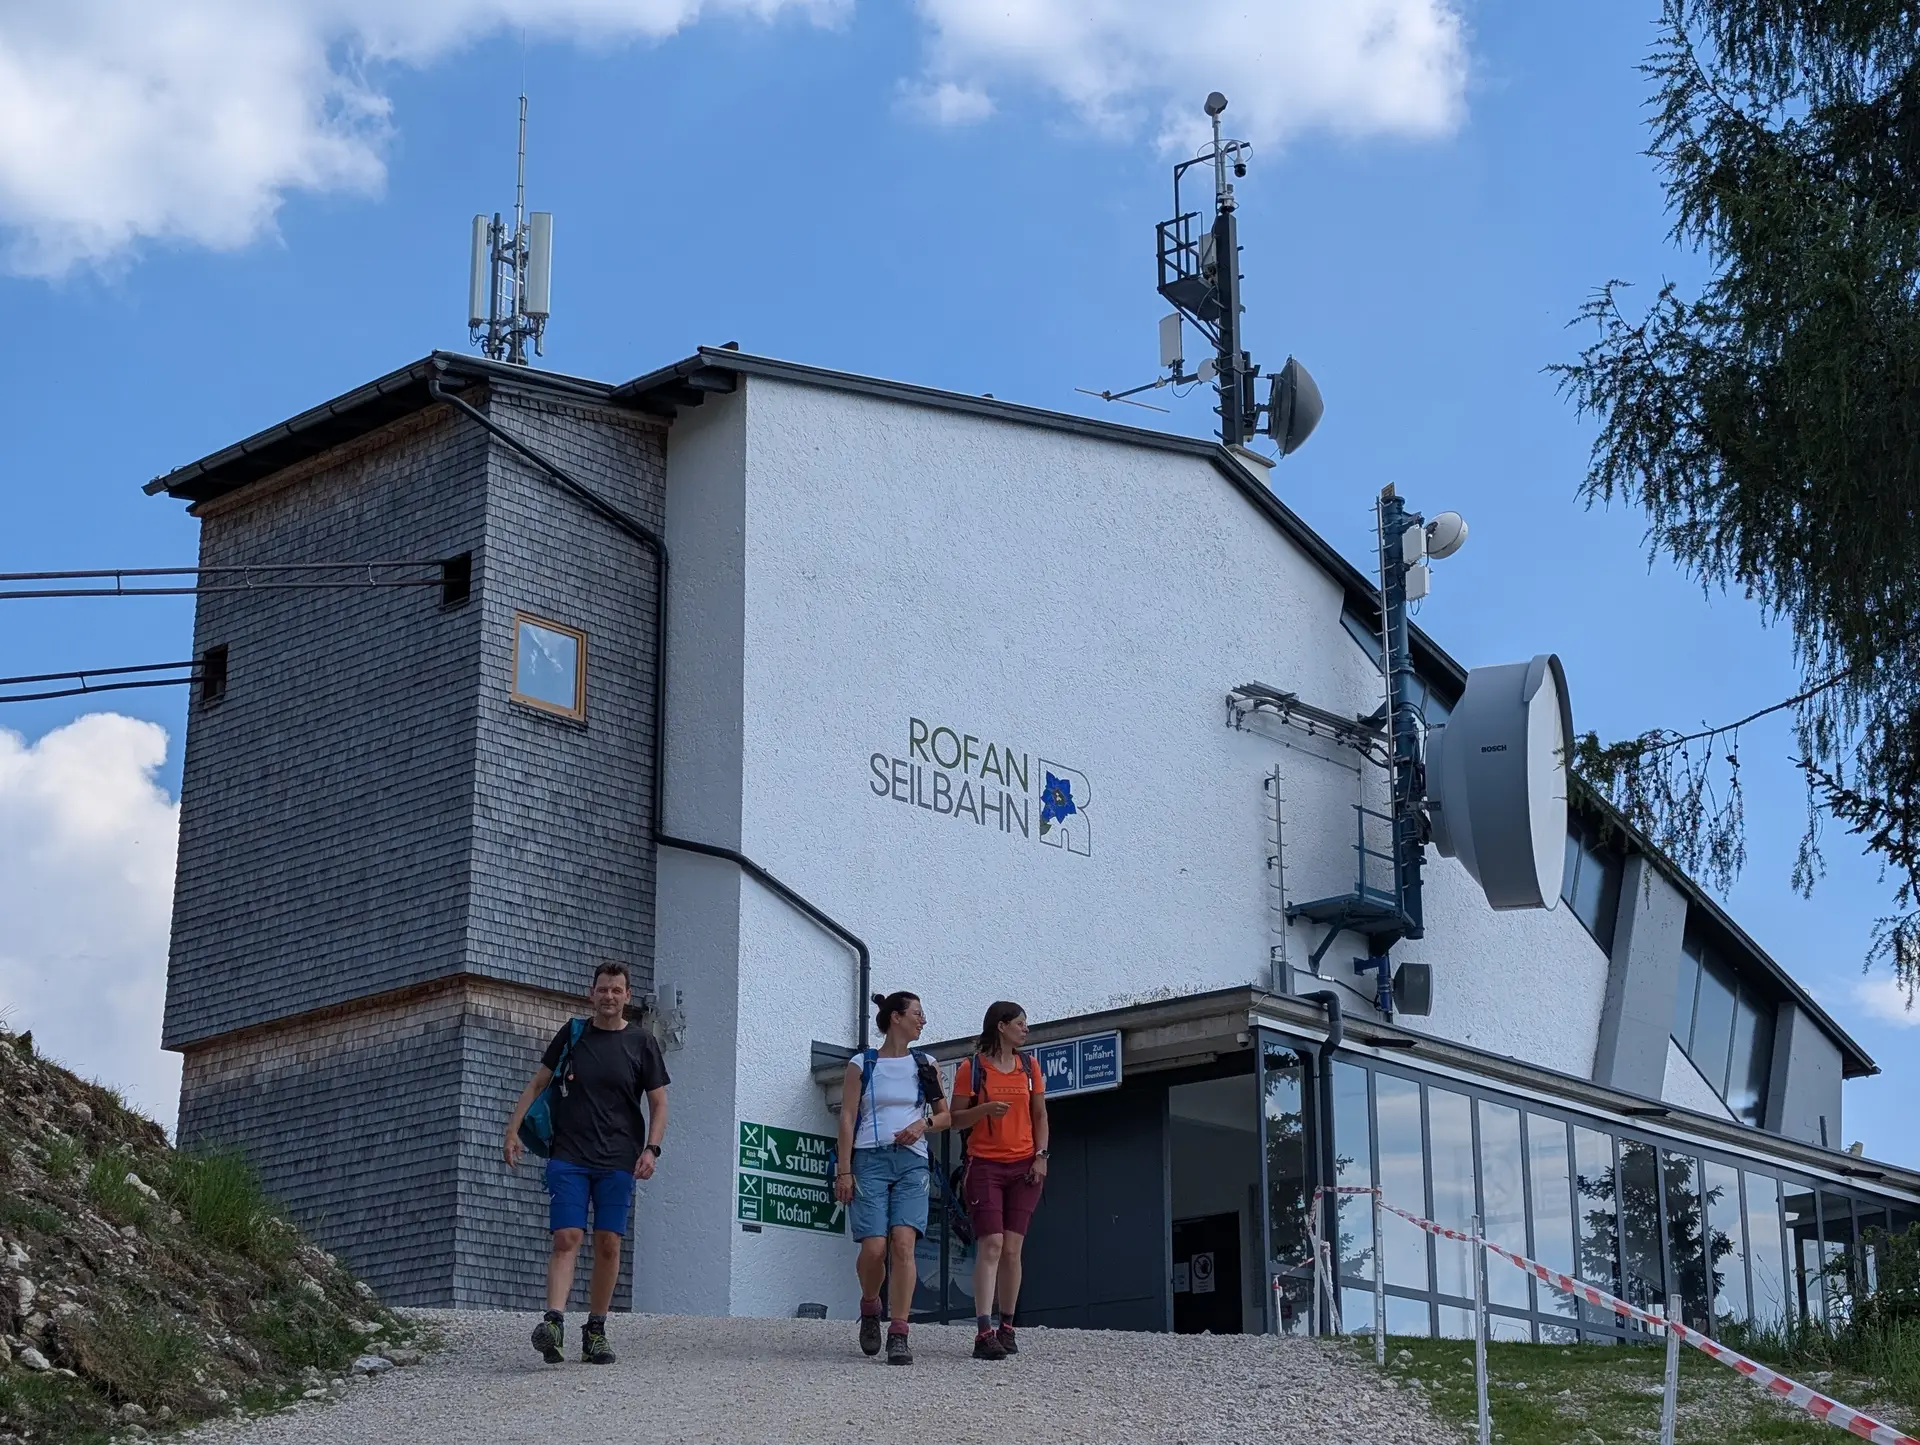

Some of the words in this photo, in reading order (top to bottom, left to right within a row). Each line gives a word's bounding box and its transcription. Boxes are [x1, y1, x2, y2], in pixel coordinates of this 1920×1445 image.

[910, 716, 1028, 793] ROFAN
[1481, 744, 1507, 753] BOSCH
[870, 753, 1028, 839] SEILBAHN
[1092, 1044, 1104, 1052] Zur
[1046, 1056, 1068, 1077] WC
